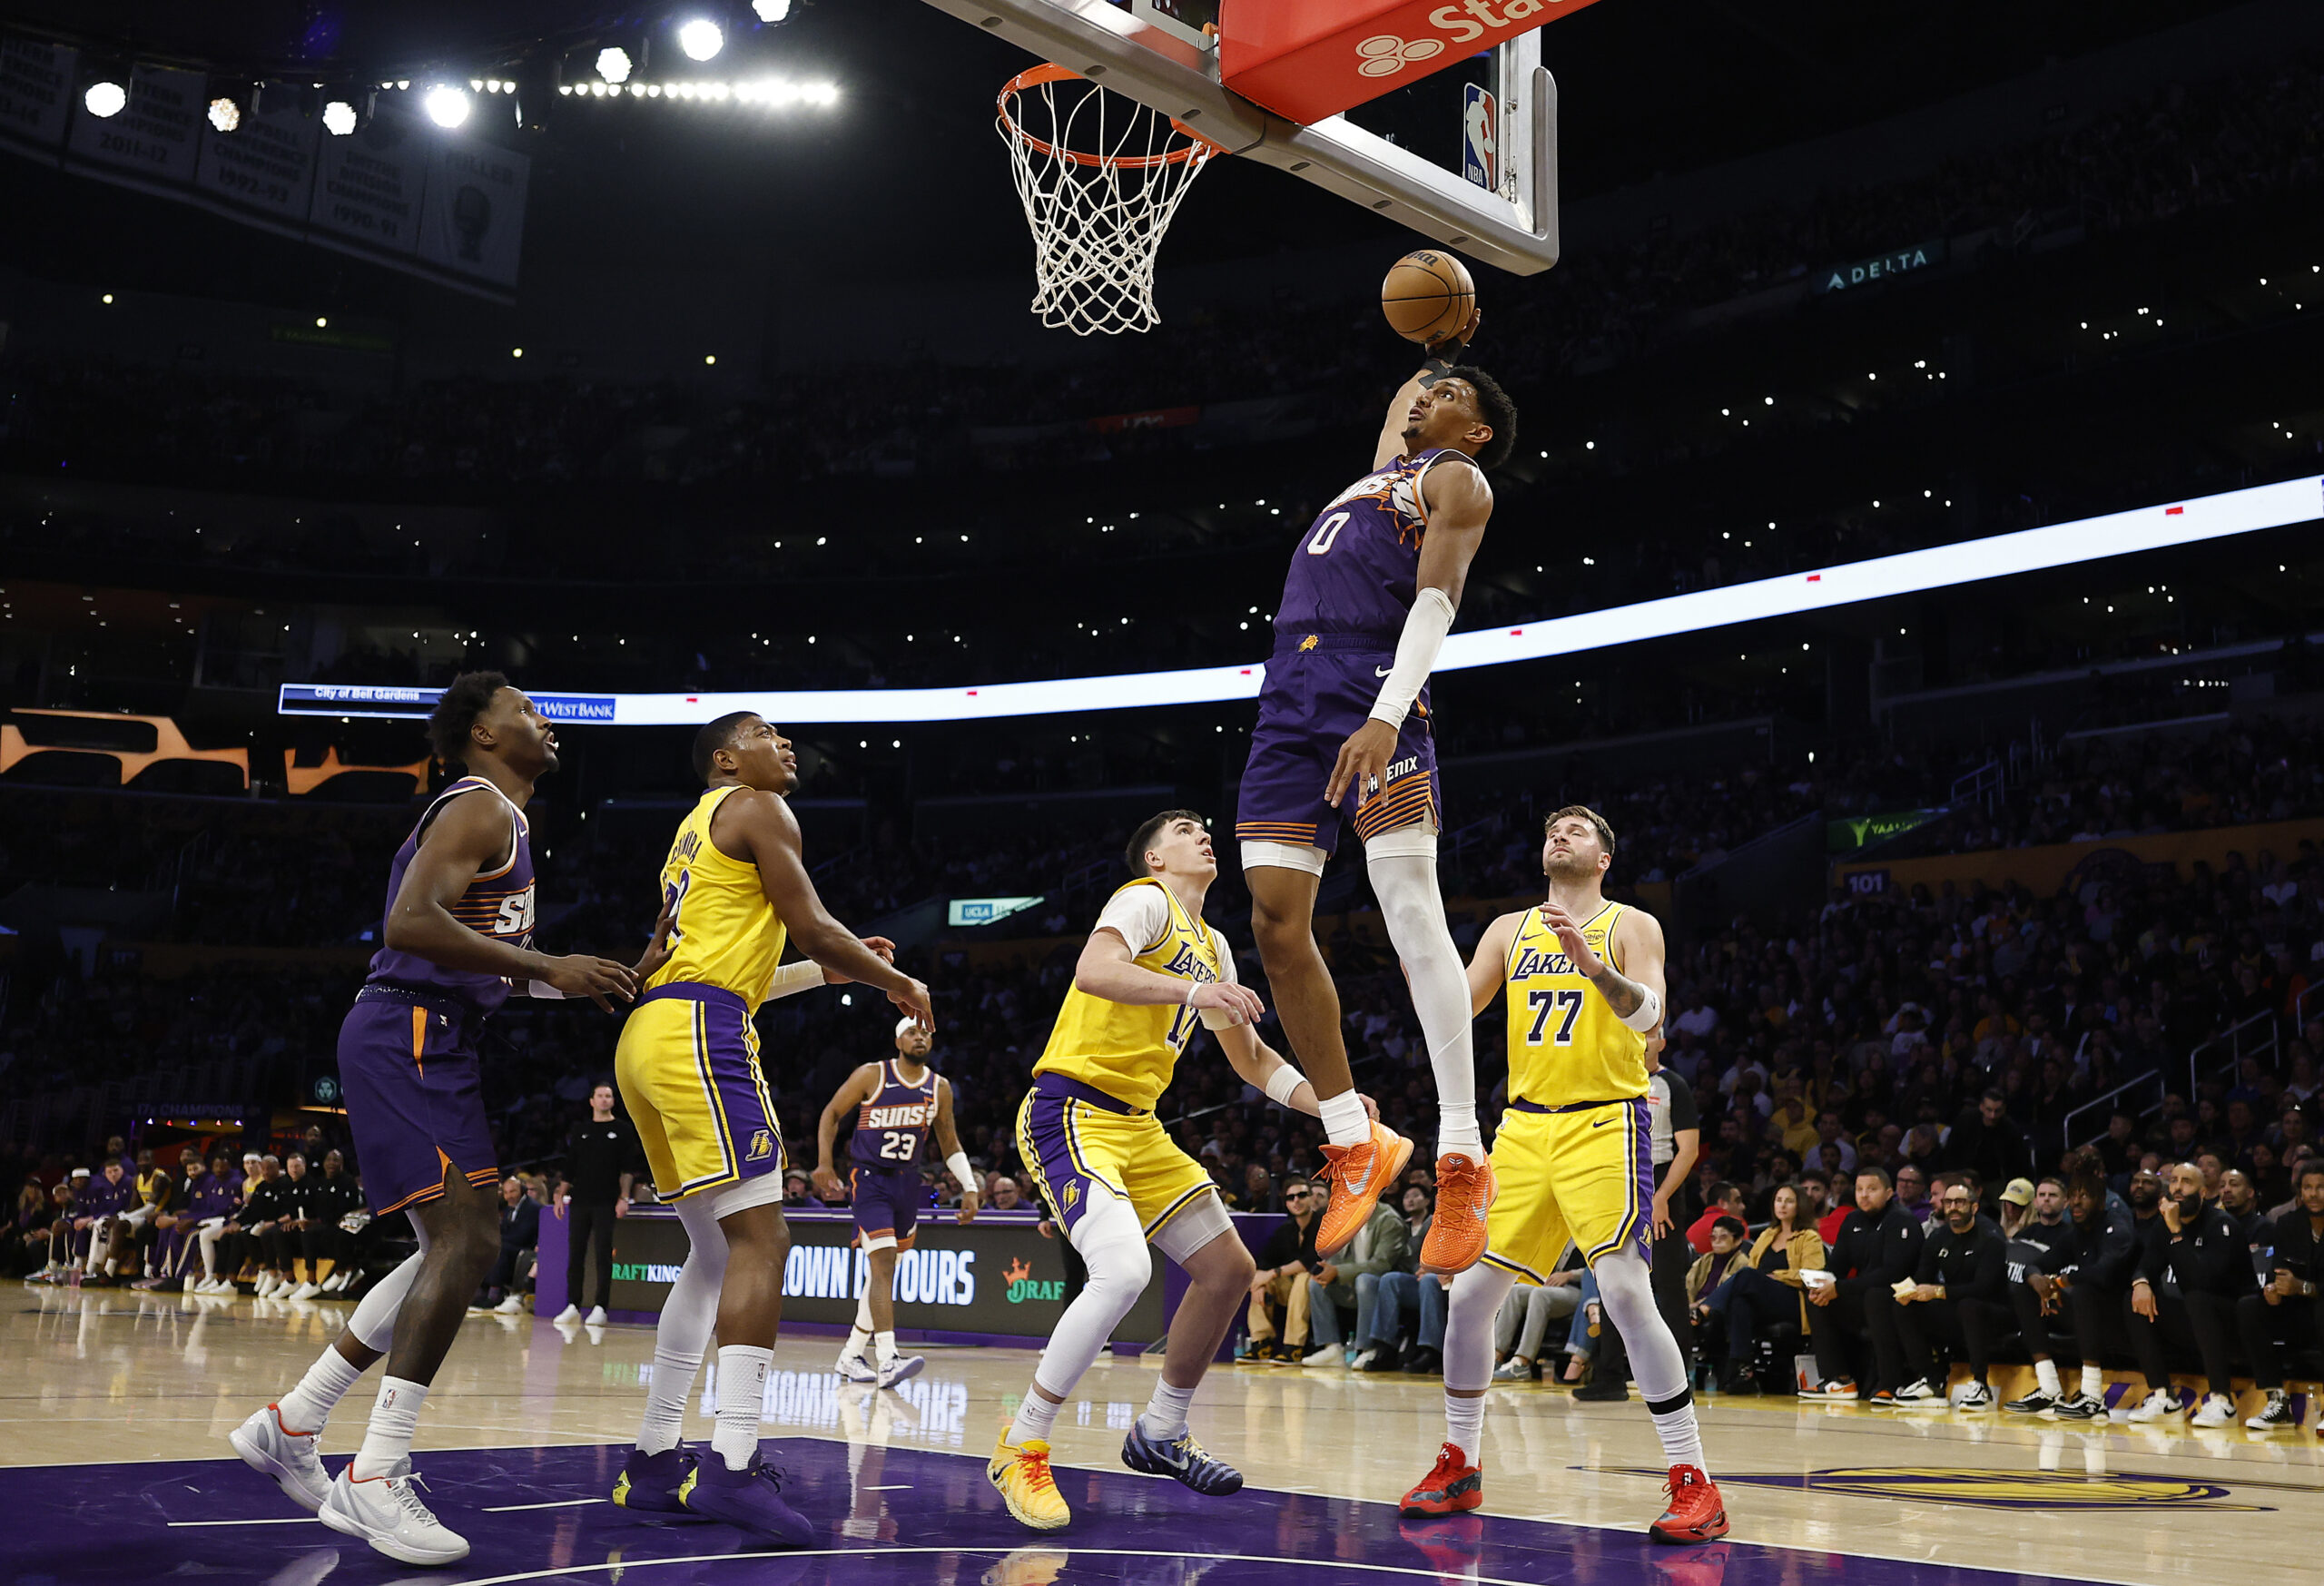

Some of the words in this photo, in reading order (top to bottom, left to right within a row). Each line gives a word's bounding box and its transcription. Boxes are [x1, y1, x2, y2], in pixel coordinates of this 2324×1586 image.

[1429, 0, 1564, 43] Sta
[1467, 163, 1483, 186] NBA
[1852, 251, 1926, 283] DELTA
[1307, 512, 1350, 555] 0
[1367, 756, 1418, 793] HENIX
[1849, 874, 1883, 894] 101
[964, 907, 990, 918] UCLA
[1510, 949, 1600, 980] LAKE
[1527, 990, 1583, 1044] 77
[160, 1104, 244, 1118] CHAMPIONS
[869, 1105, 925, 1128] SUNS
[881, 1131, 917, 1160] 23
[612, 1263, 683, 1283] RAFTKING
[783, 1245, 851, 1299] OWN
[891, 1248, 975, 1305] OURS
[1007, 1278, 1066, 1304] DRAF
